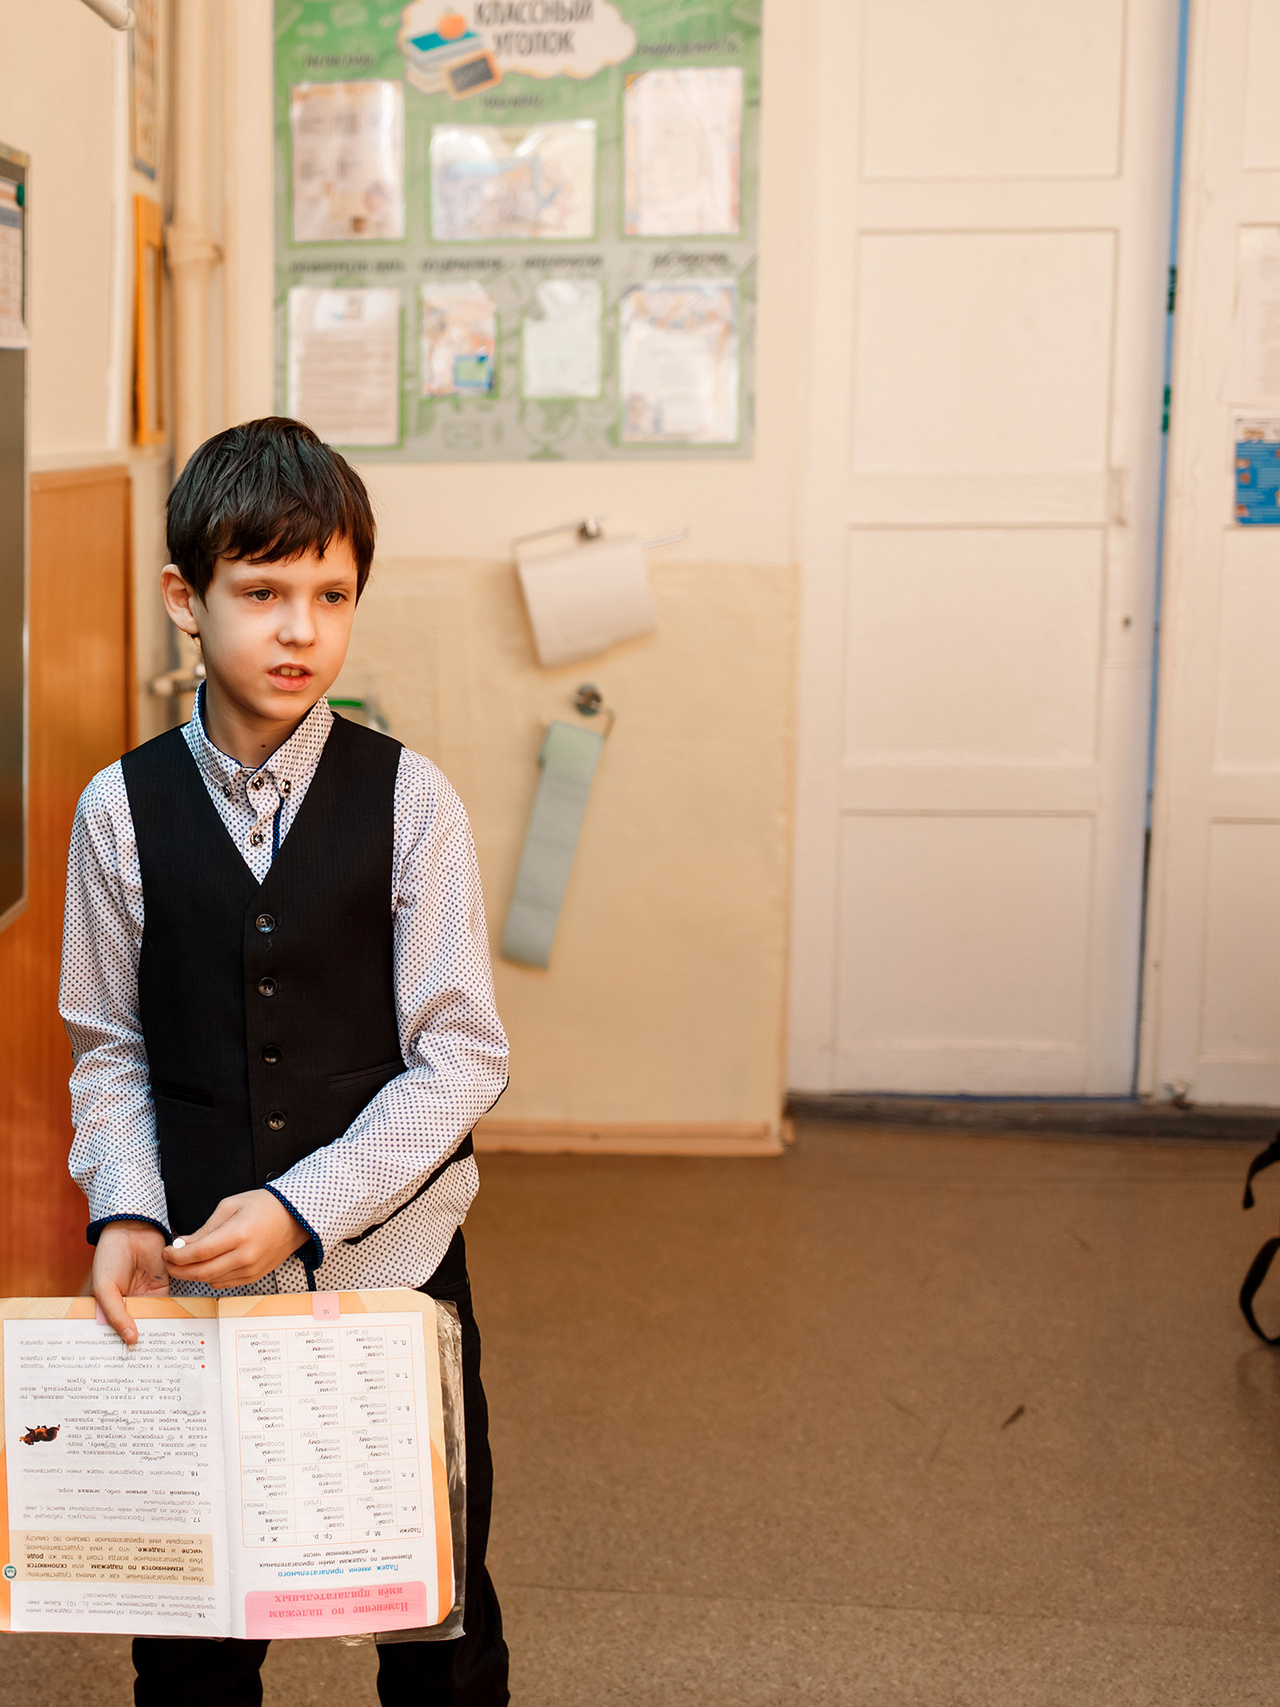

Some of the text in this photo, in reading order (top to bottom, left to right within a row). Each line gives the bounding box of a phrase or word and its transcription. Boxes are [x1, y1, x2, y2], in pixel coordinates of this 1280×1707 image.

[490, 30, 577, 56] УГОЛОК
[278, 1567, 344, 1577] прилагательного
[376, 1563, 398, 1572] Падеж
[275, 1587, 402, 1603] имён прилагательных
[269, 1601, 408, 1618] Изменение по падежам
